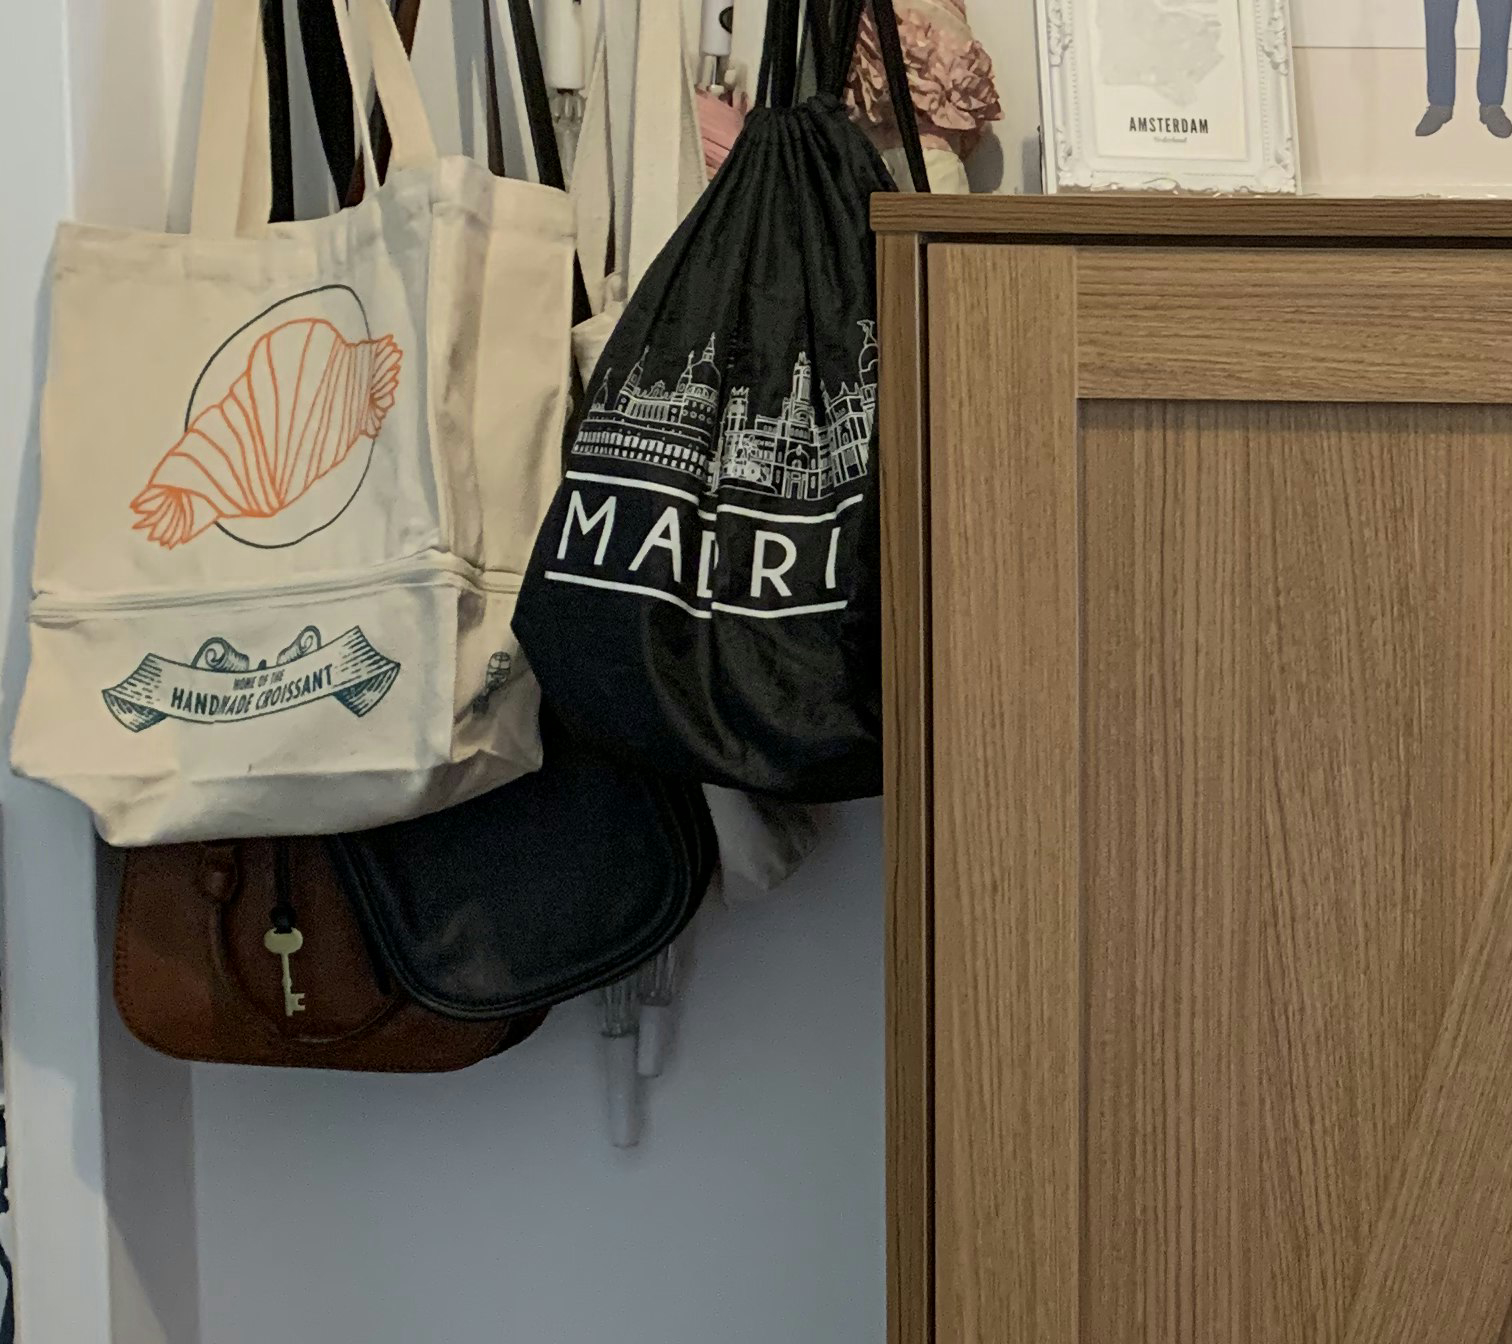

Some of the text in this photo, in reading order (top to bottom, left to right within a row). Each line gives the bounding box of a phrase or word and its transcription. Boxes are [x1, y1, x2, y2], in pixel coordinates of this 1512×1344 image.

[1129, 116, 1209, 134] AMSTERDAM
[170, 663, 333, 716] HANDMADE CROISSANT
